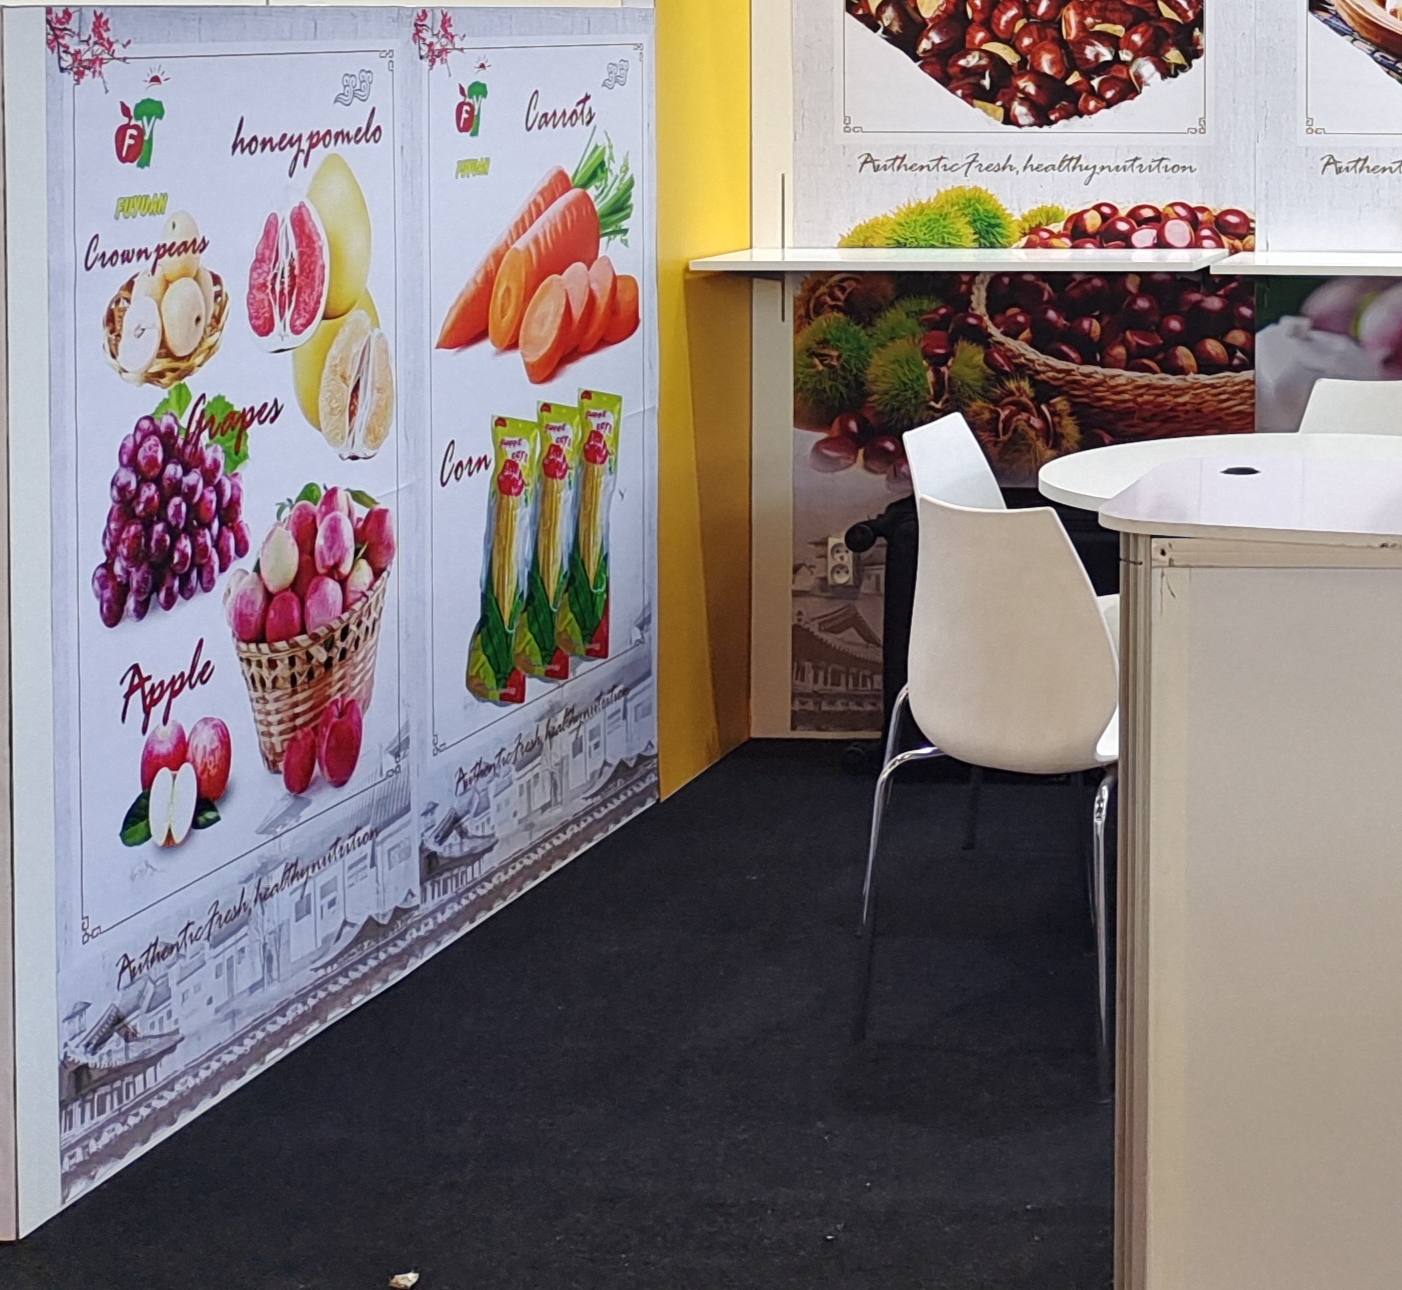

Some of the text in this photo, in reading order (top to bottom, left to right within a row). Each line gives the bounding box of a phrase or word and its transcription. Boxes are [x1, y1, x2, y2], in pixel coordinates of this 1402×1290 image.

[525, 89, 596, 132] Carrots
[182, 393, 284, 458] Grapes
[440, 439, 491, 489] Corn
[120, 637, 215, 736] Apple
